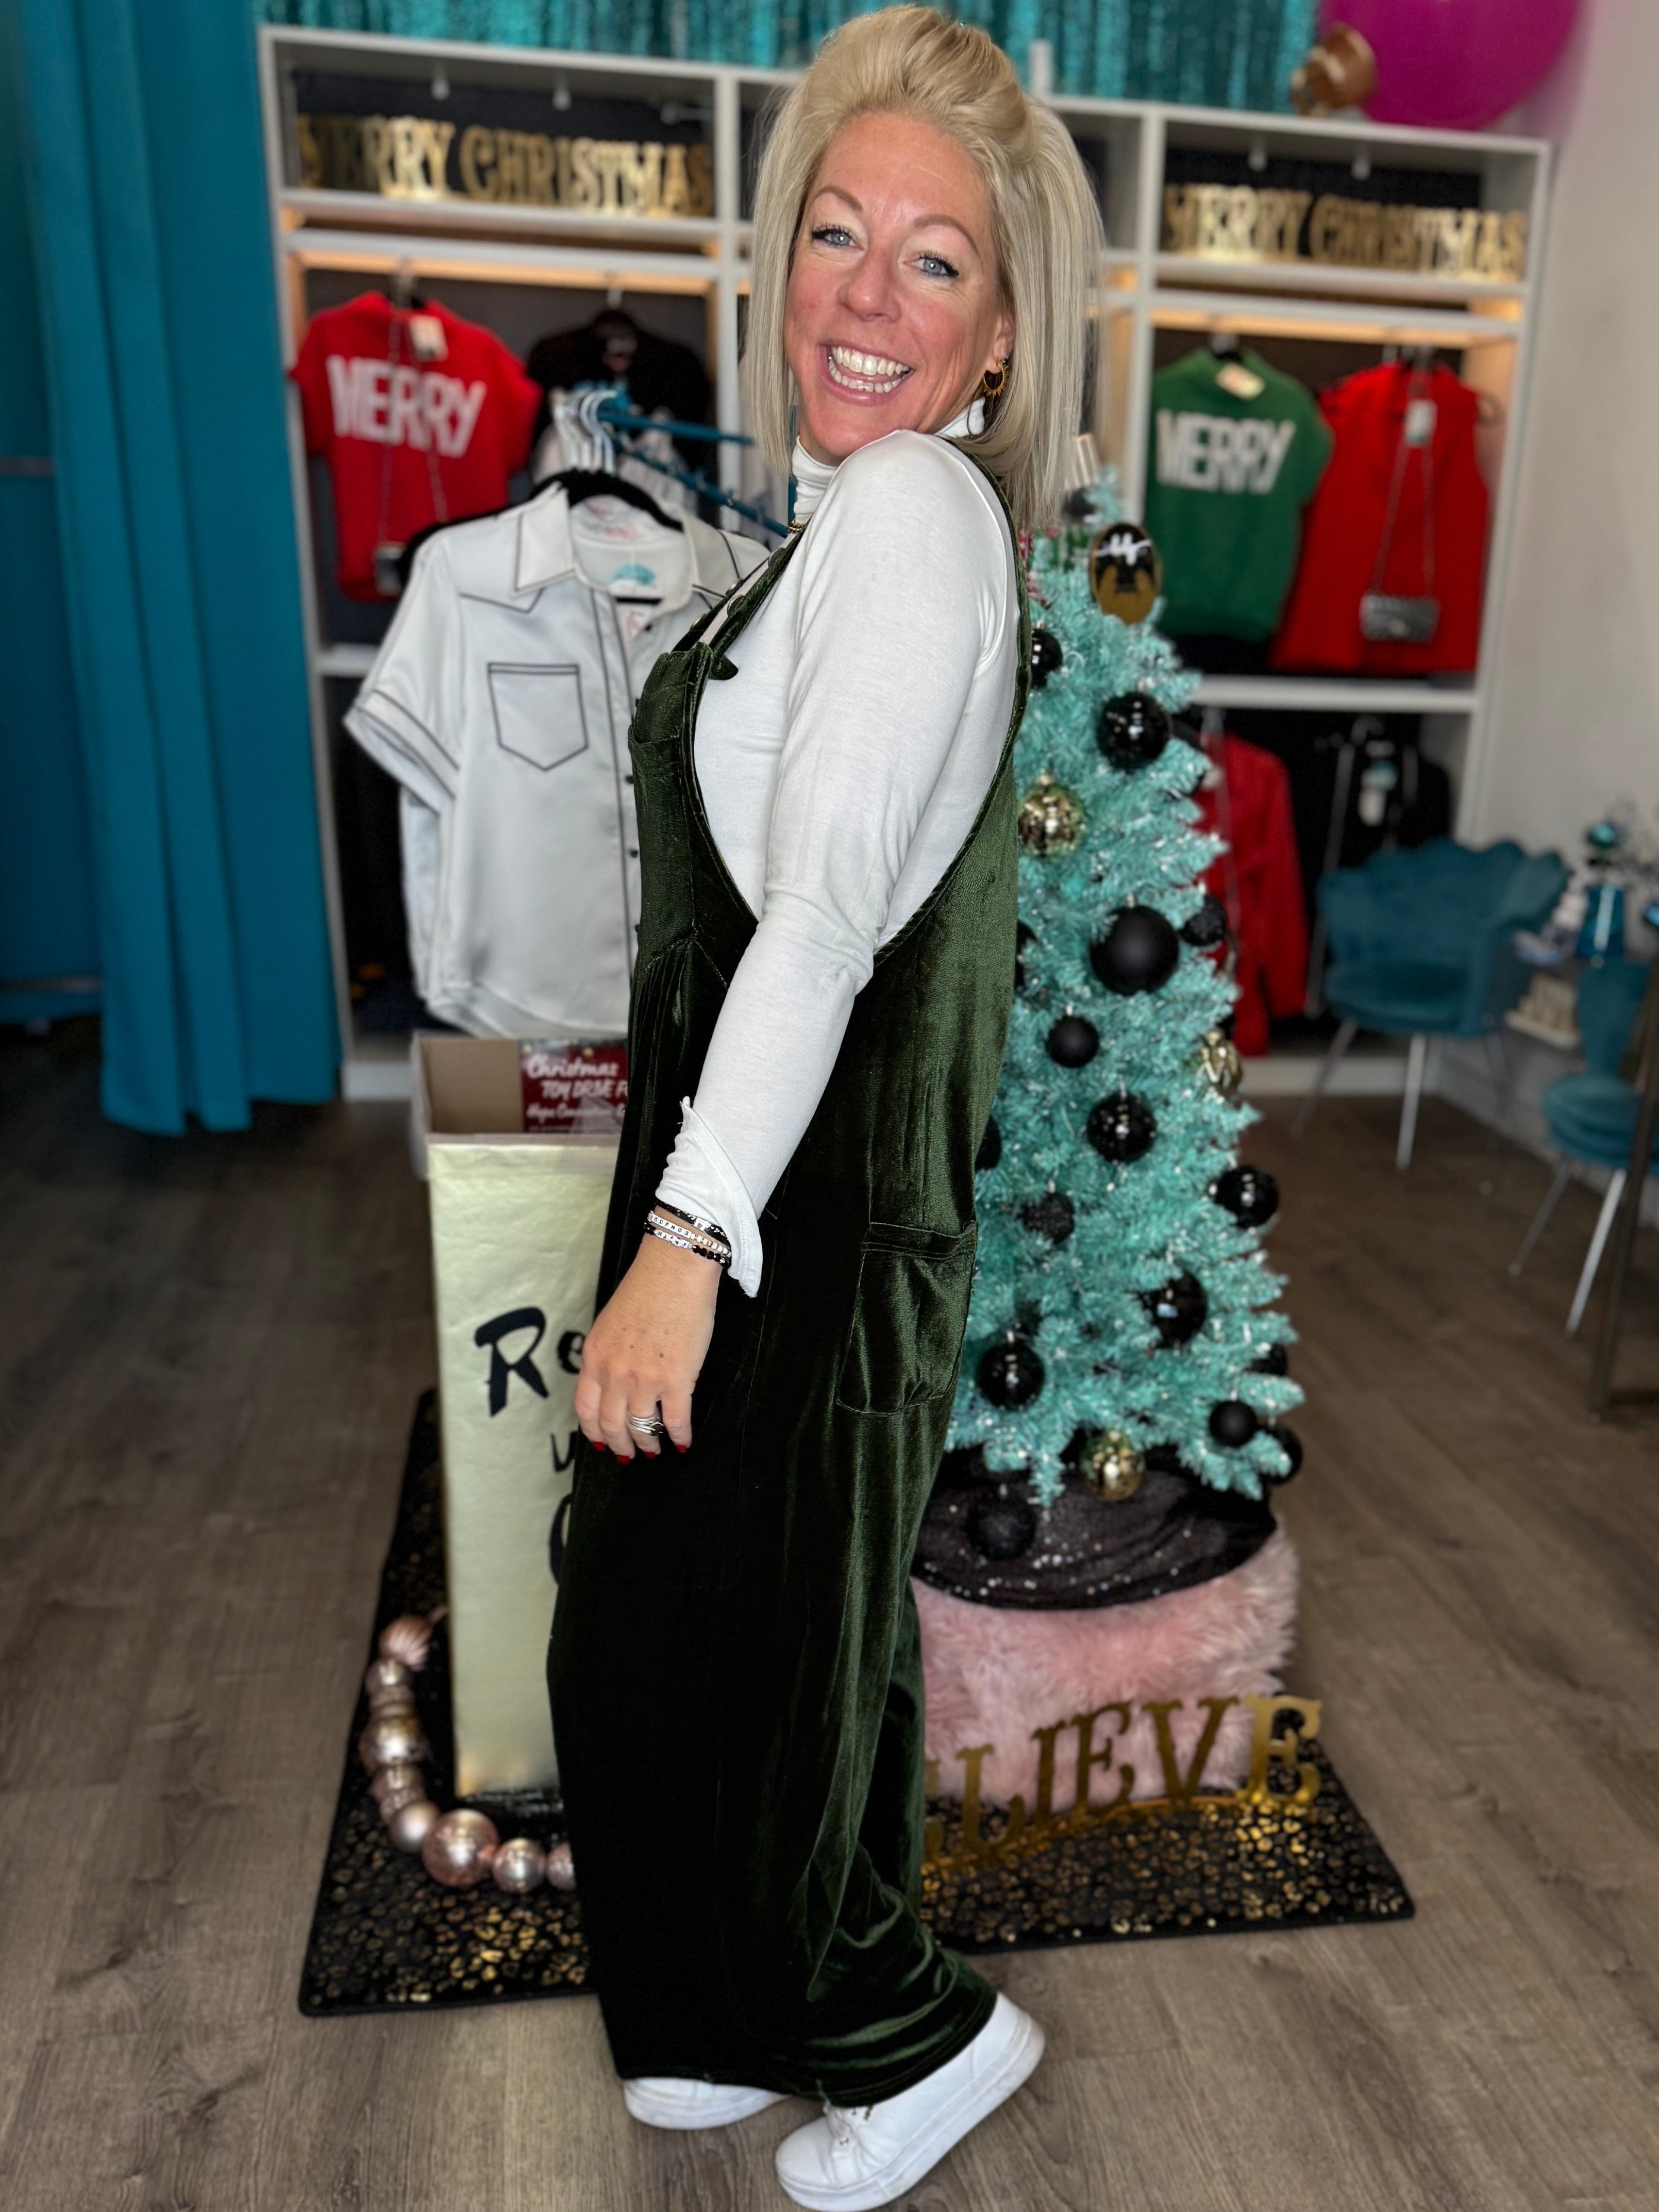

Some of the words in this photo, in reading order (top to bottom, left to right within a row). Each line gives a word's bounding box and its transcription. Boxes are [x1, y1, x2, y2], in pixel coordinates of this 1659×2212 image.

[459, 123, 715, 218] CHRISTMAS
[325, 354, 488, 459] MERRY
[1155, 407, 1296, 495] MERRY
[525, 1053, 619, 1079] Christmas
[926, 1693, 1323, 1869] LIEVE
